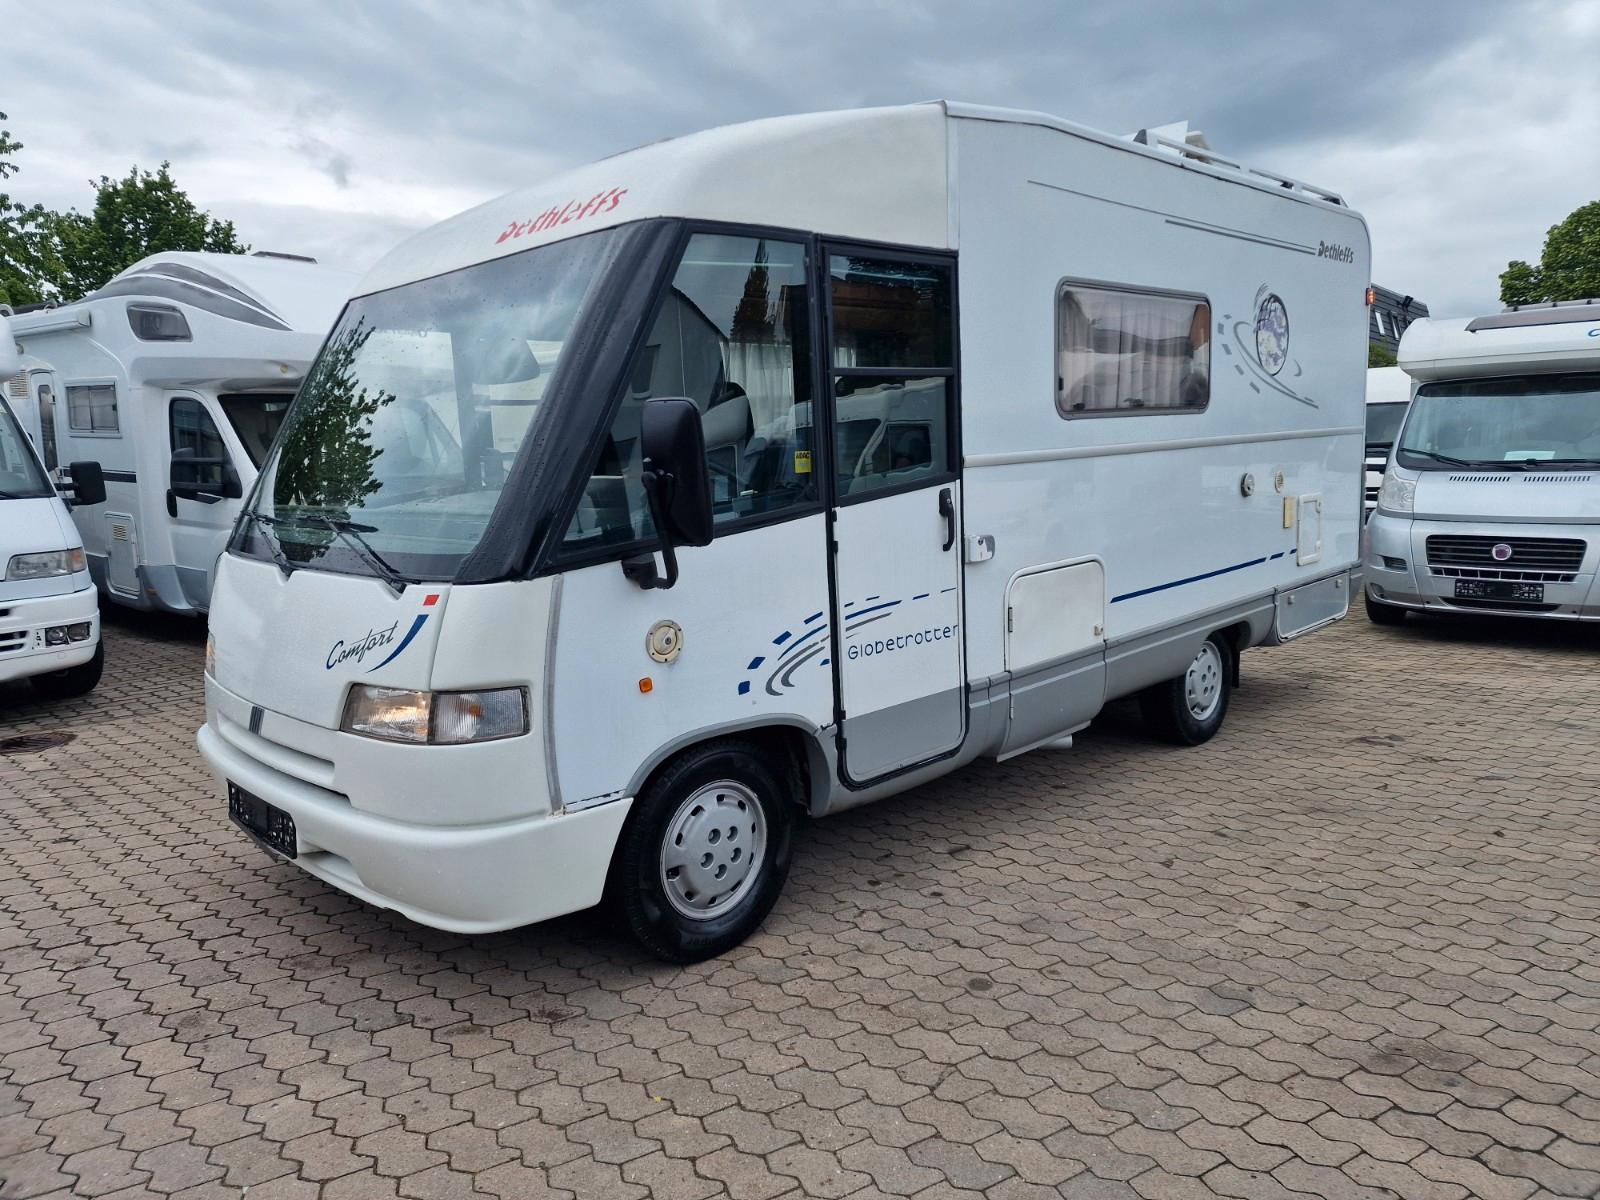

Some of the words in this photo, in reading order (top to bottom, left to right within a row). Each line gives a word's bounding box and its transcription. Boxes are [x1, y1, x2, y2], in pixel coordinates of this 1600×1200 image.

[495, 186, 629, 244] Dethleffs
[1317, 240, 1355, 264] Dethleffs
[325, 619, 399, 670] Comfort
[847, 624, 959, 660] Globetrotter
